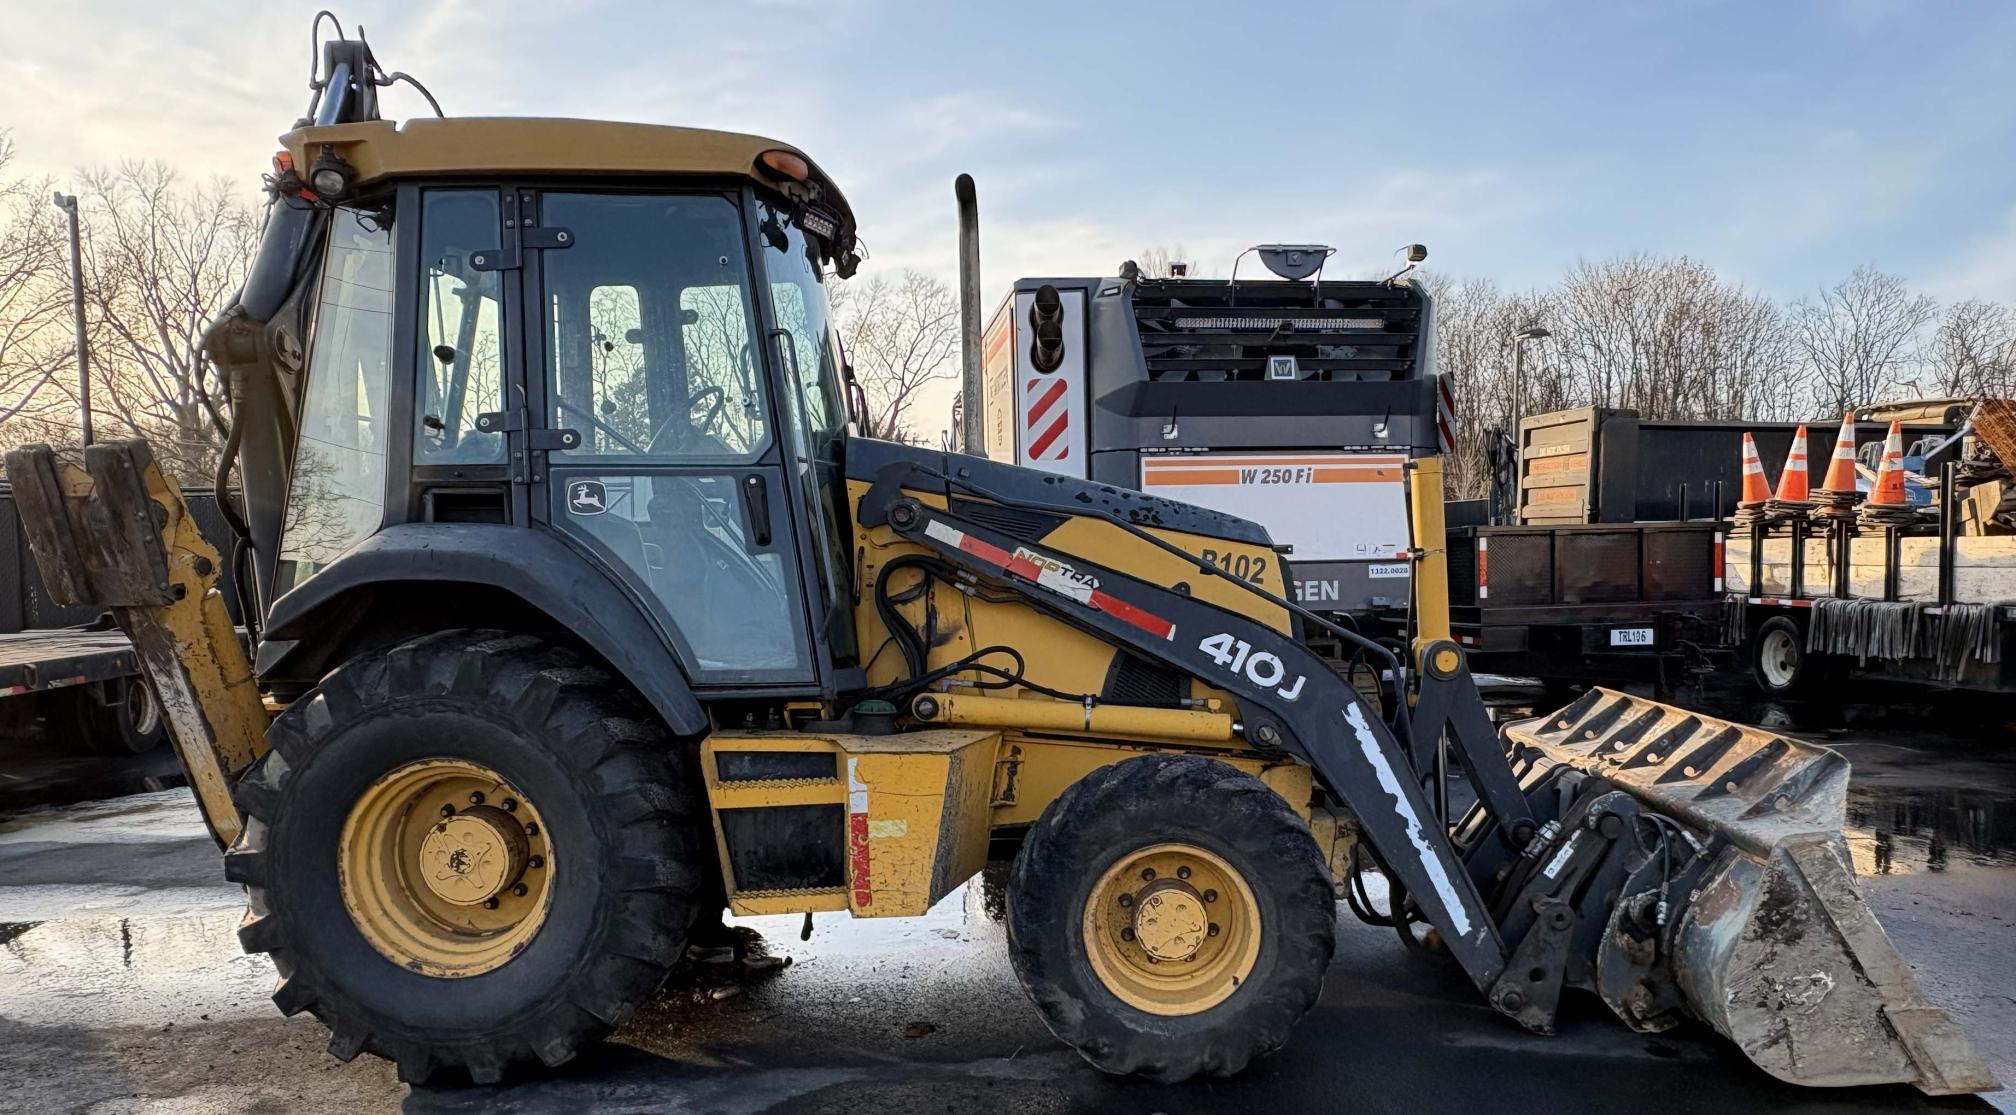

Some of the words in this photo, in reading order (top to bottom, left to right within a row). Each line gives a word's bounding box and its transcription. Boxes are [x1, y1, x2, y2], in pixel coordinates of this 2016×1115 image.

[1241, 469, 1257, 484] W
[1260, 468, 1292, 484] 250
[1200, 549, 1266, 584] B102
[1618, 630, 1646, 642] TRL106
[1199, 632, 1307, 701] 410J
